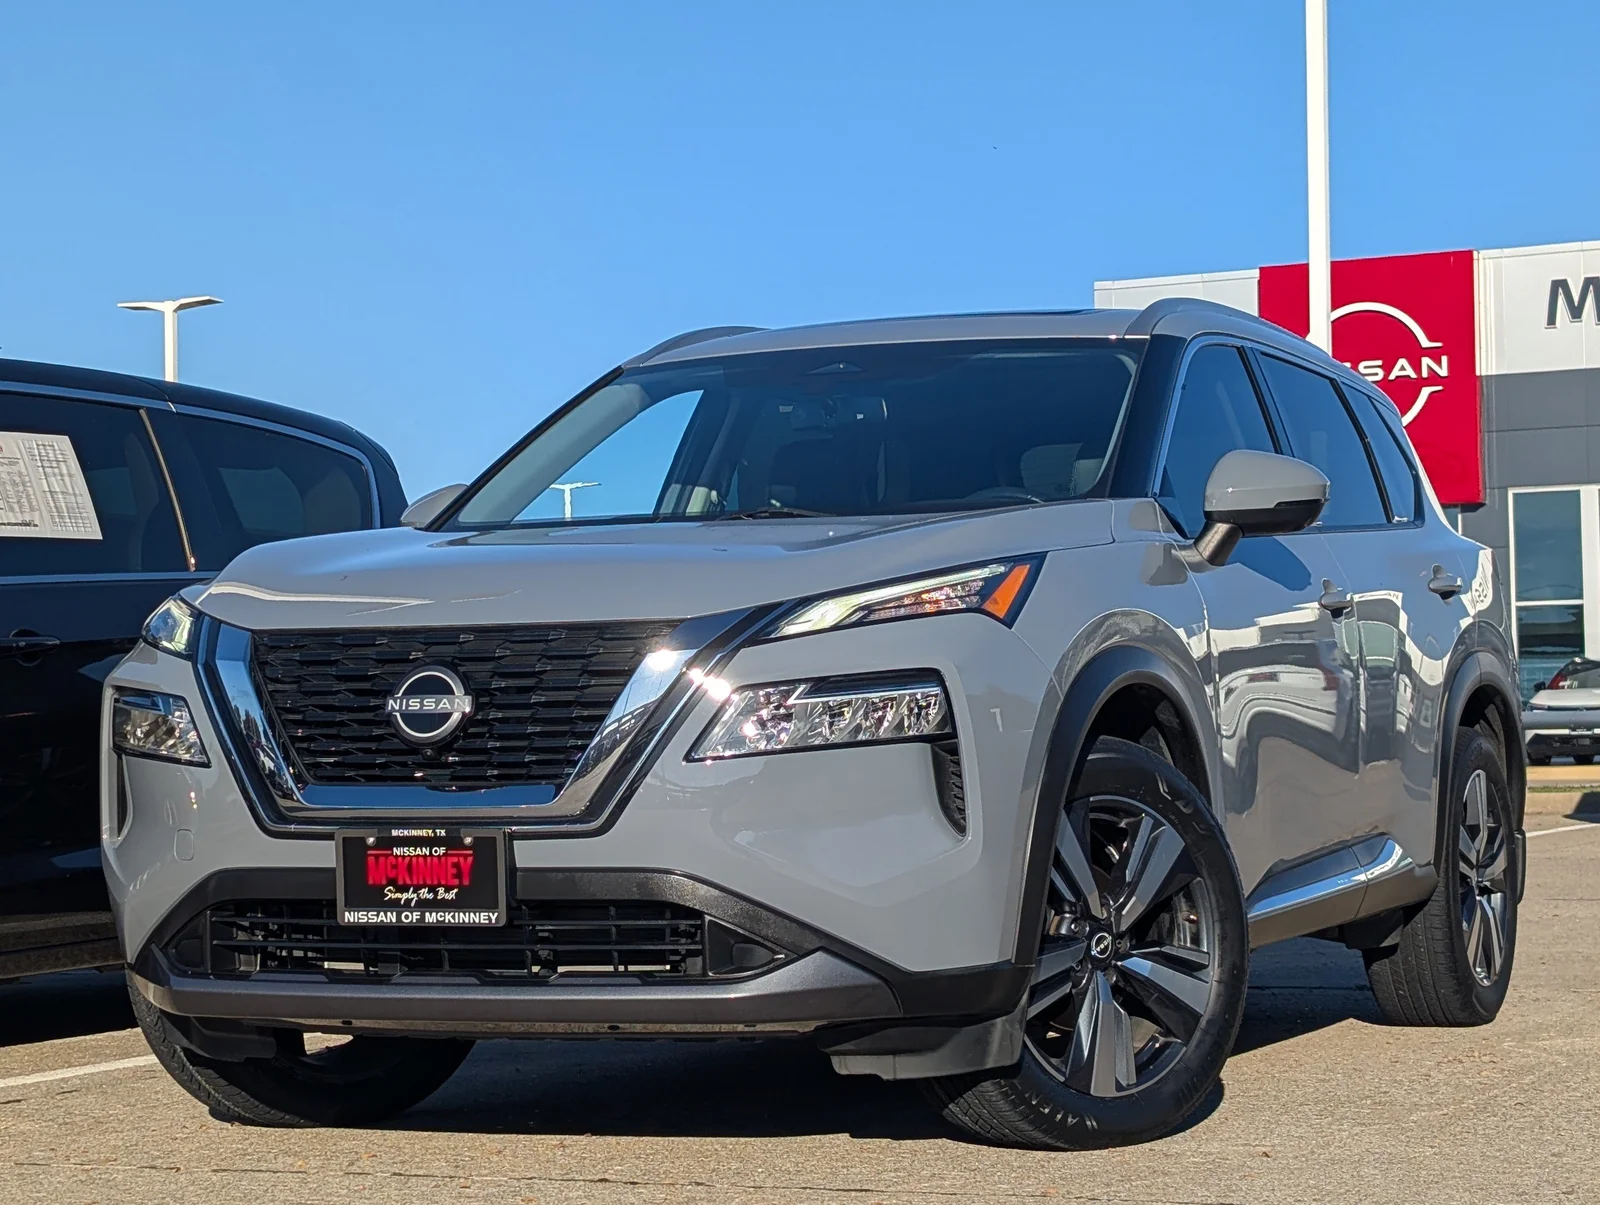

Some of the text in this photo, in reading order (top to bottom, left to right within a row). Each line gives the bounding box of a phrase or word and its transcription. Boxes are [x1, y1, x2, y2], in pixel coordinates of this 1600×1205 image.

[387, 698, 469, 711] NISSAN
[436, 829, 446, 837] TX
[393, 847, 446, 856] NISSAN OF
[383, 886, 459, 908] Simply the Best
[344, 911, 499, 924] NISSAN OF McKINNEY
